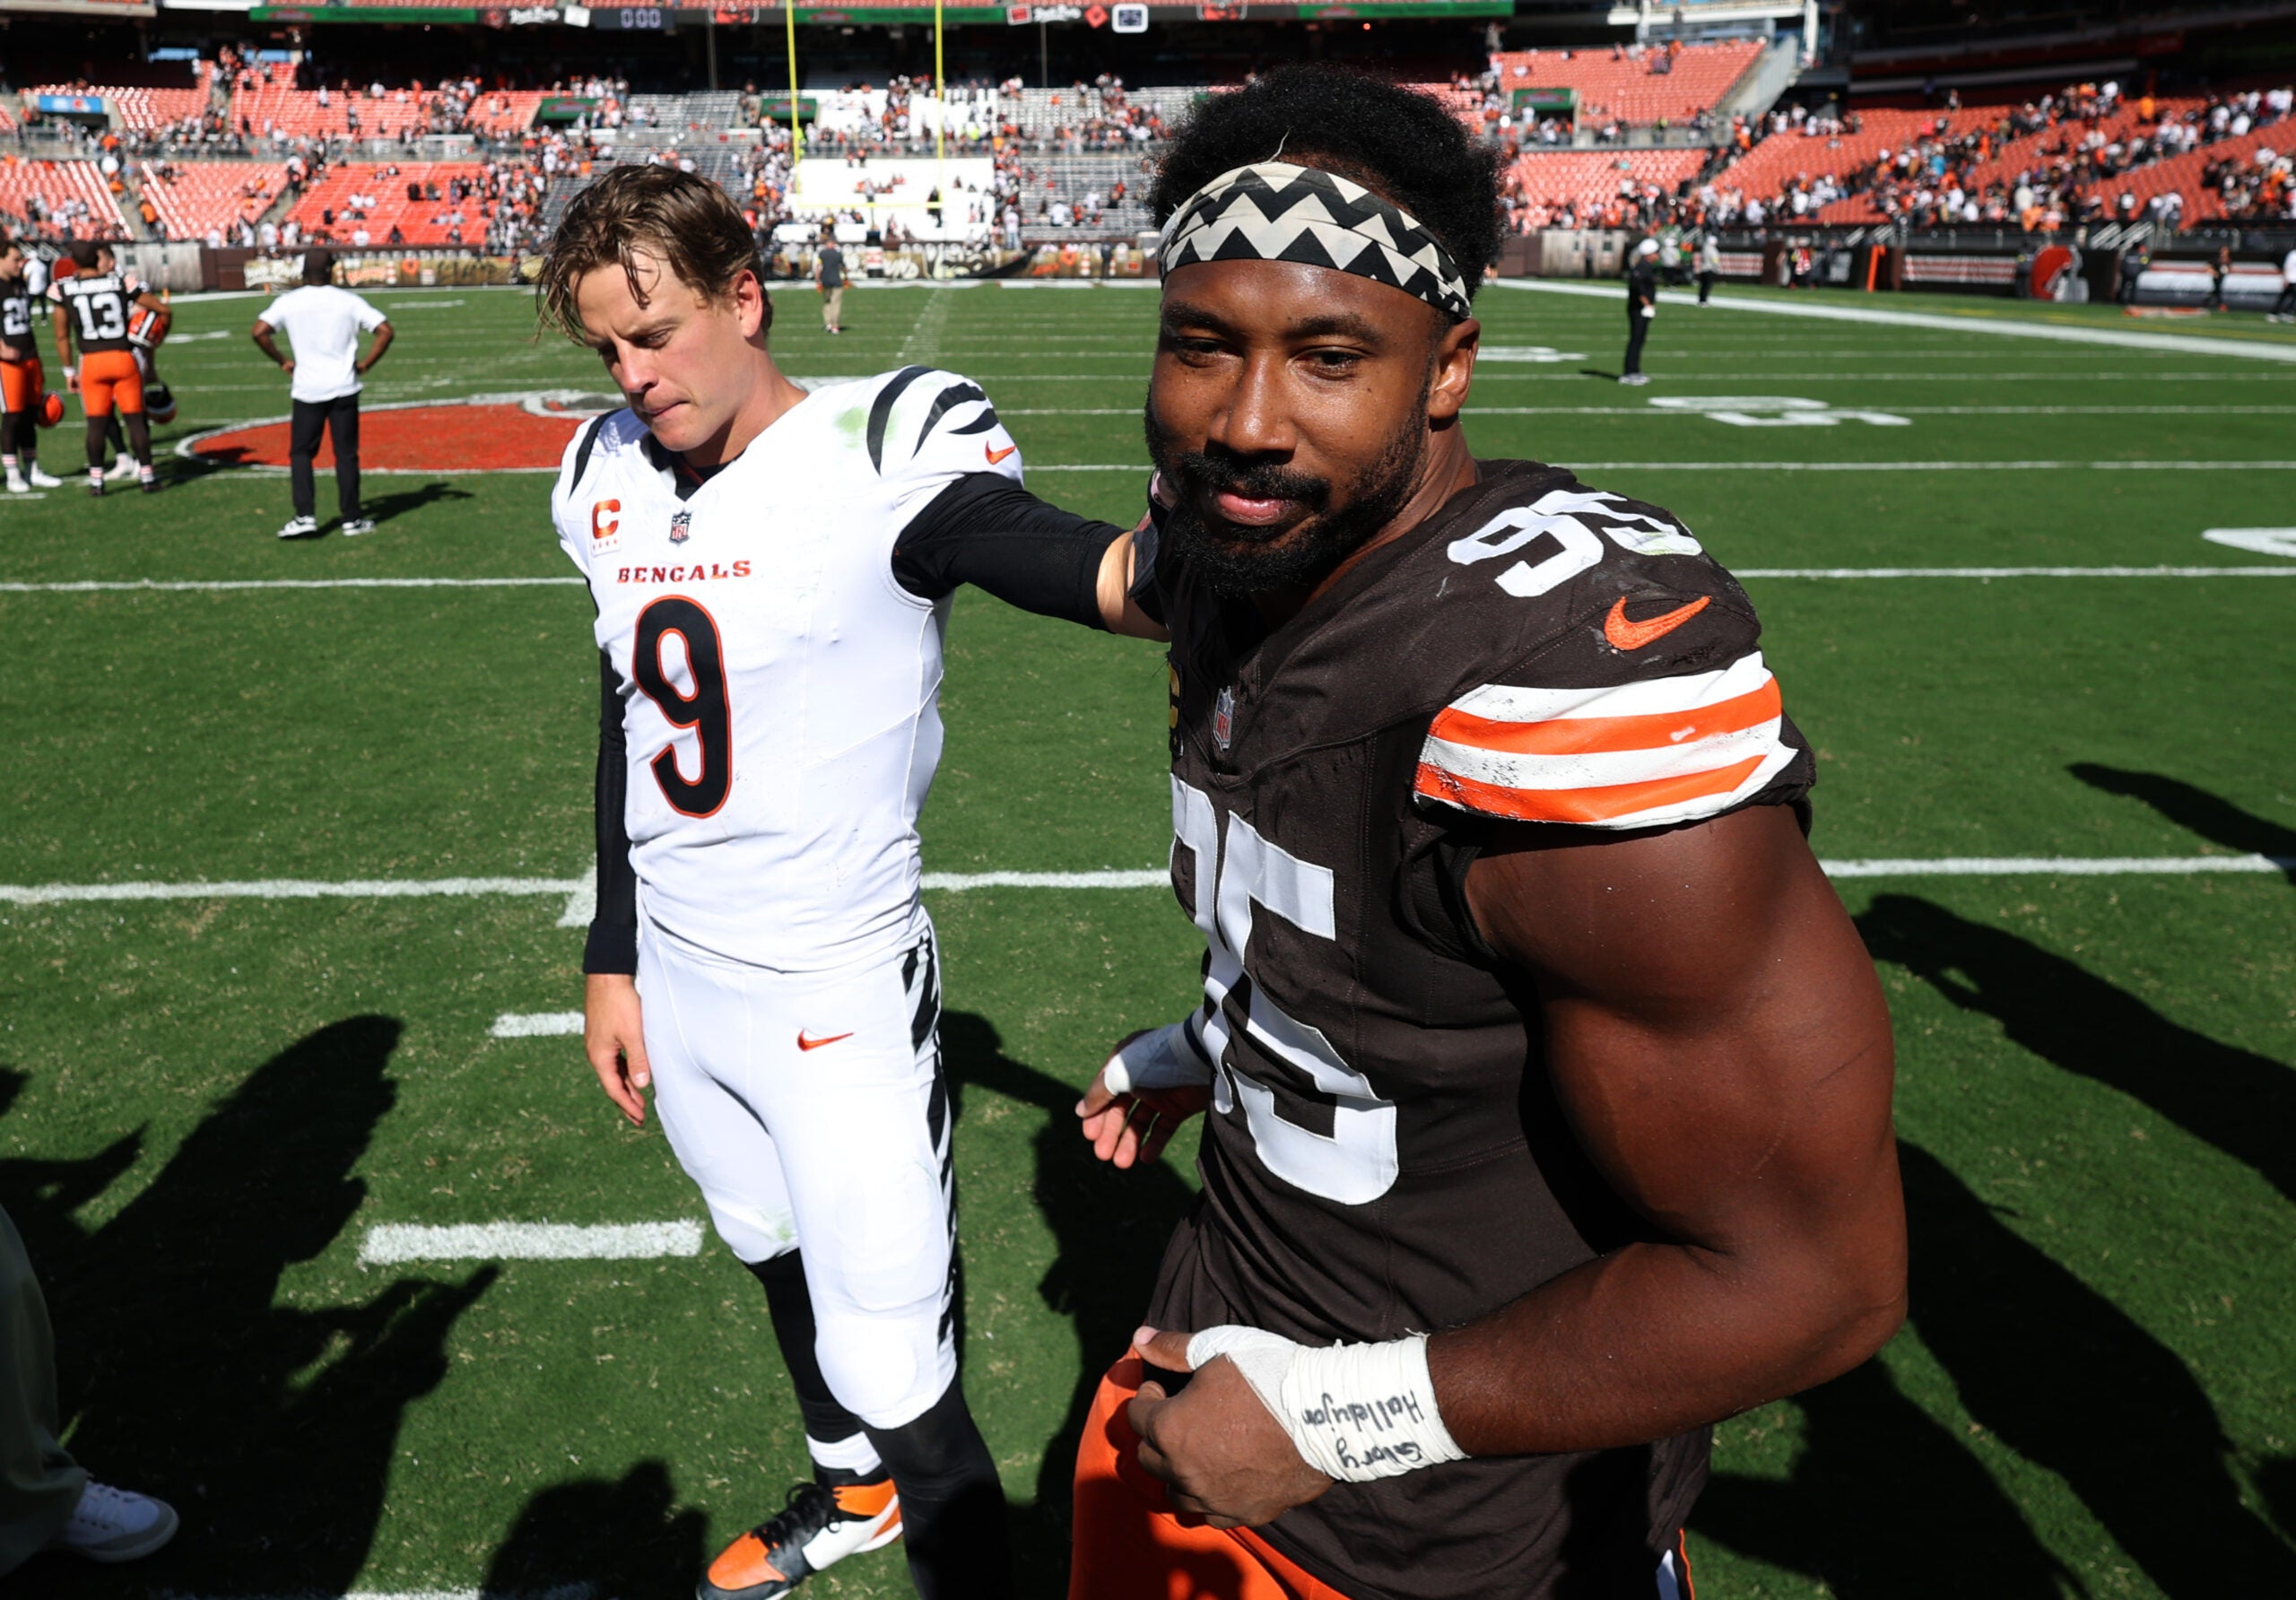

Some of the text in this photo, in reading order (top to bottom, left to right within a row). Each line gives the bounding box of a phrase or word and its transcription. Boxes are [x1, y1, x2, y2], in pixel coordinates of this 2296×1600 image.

[73, 291, 126, 340] 13
[592, 499, 621, 540] C
[1447, 489, 1703, 598] 95
[617, 560, 752, 584] BENGALS
[631, 594, 733, 820] 9
[1335, 1437, 1422, 1469] Glory
